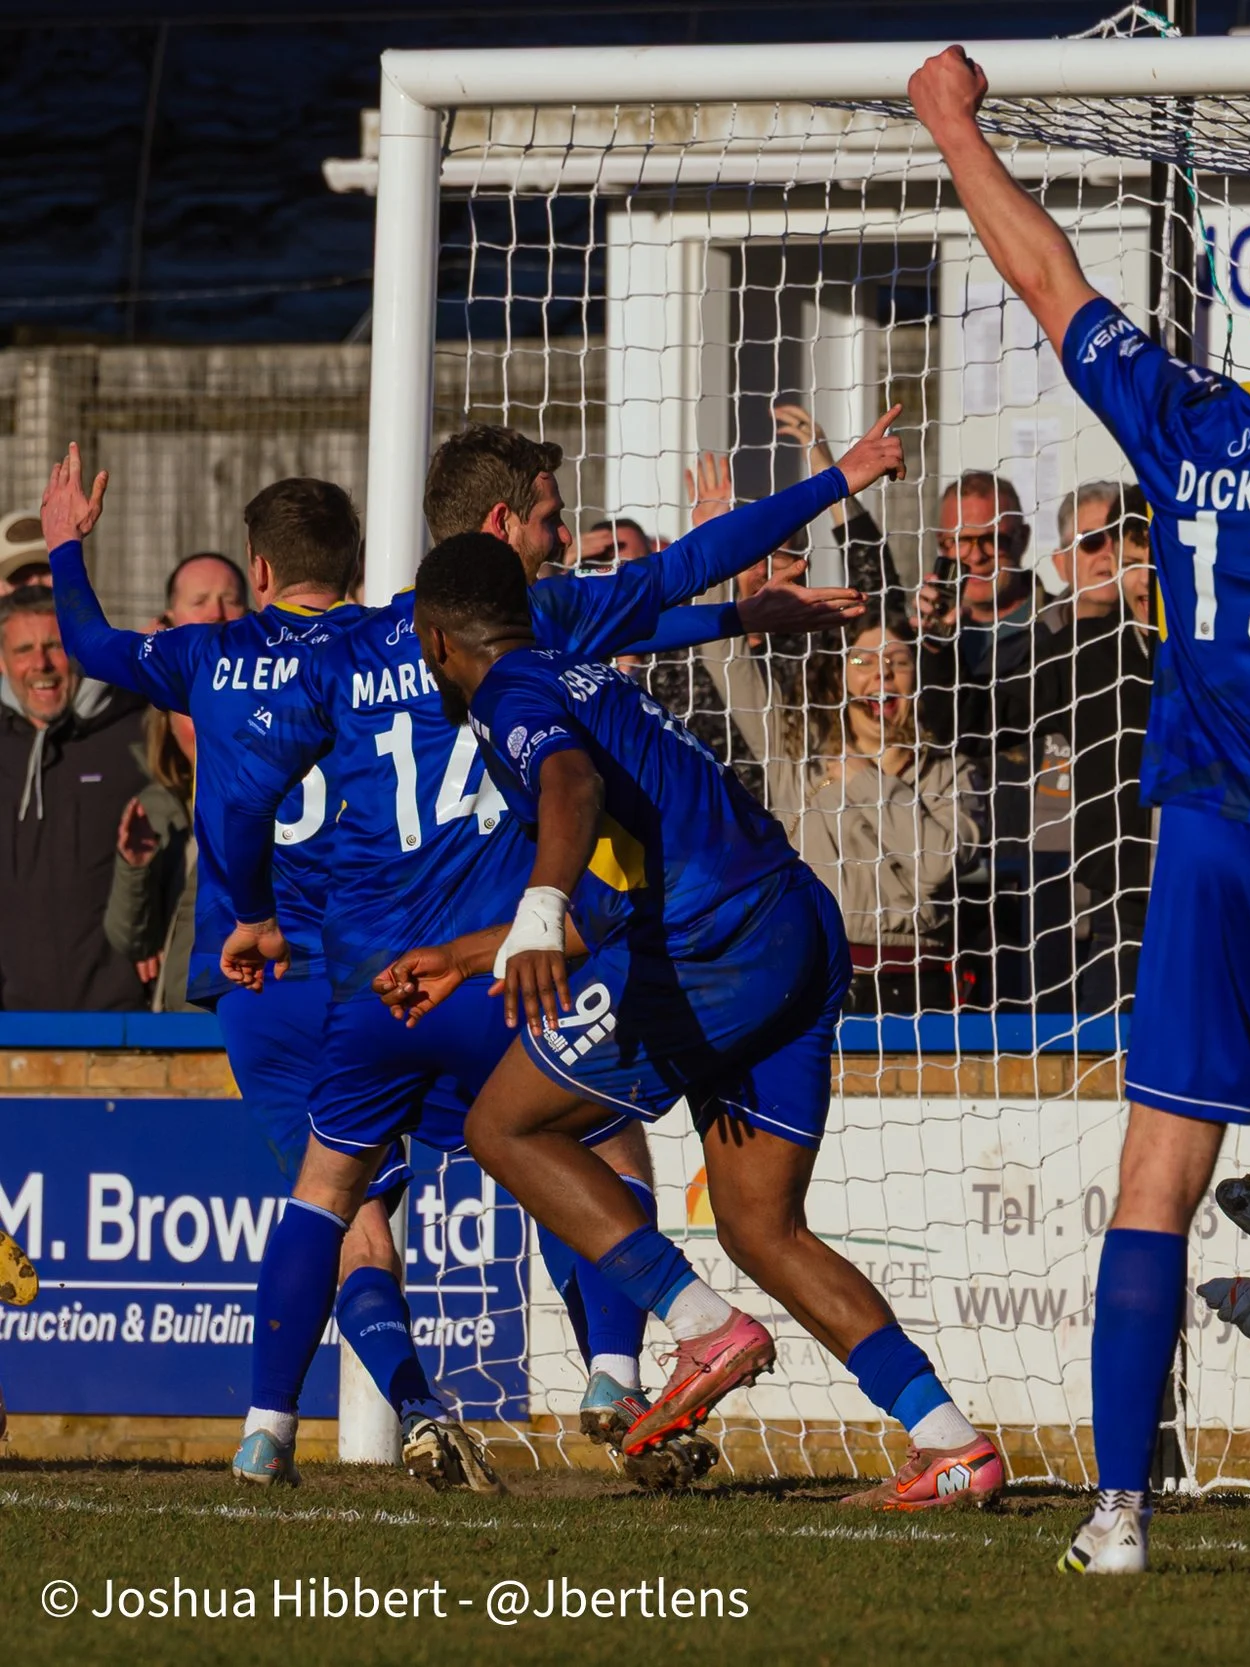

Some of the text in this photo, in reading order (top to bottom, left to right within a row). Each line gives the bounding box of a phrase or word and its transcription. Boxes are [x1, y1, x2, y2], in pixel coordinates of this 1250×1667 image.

[374, 711, 509, 852] 14
[557, 982, 611, 1029] 9
[87, 1172, 290, 1263] Brow
[405, 1184, 496, 1266] td
[971, 1183, 1036, 1236] Tel
[120, 1302, 145, 1343] &
[150, 1303, 255, 1344] Buildin
